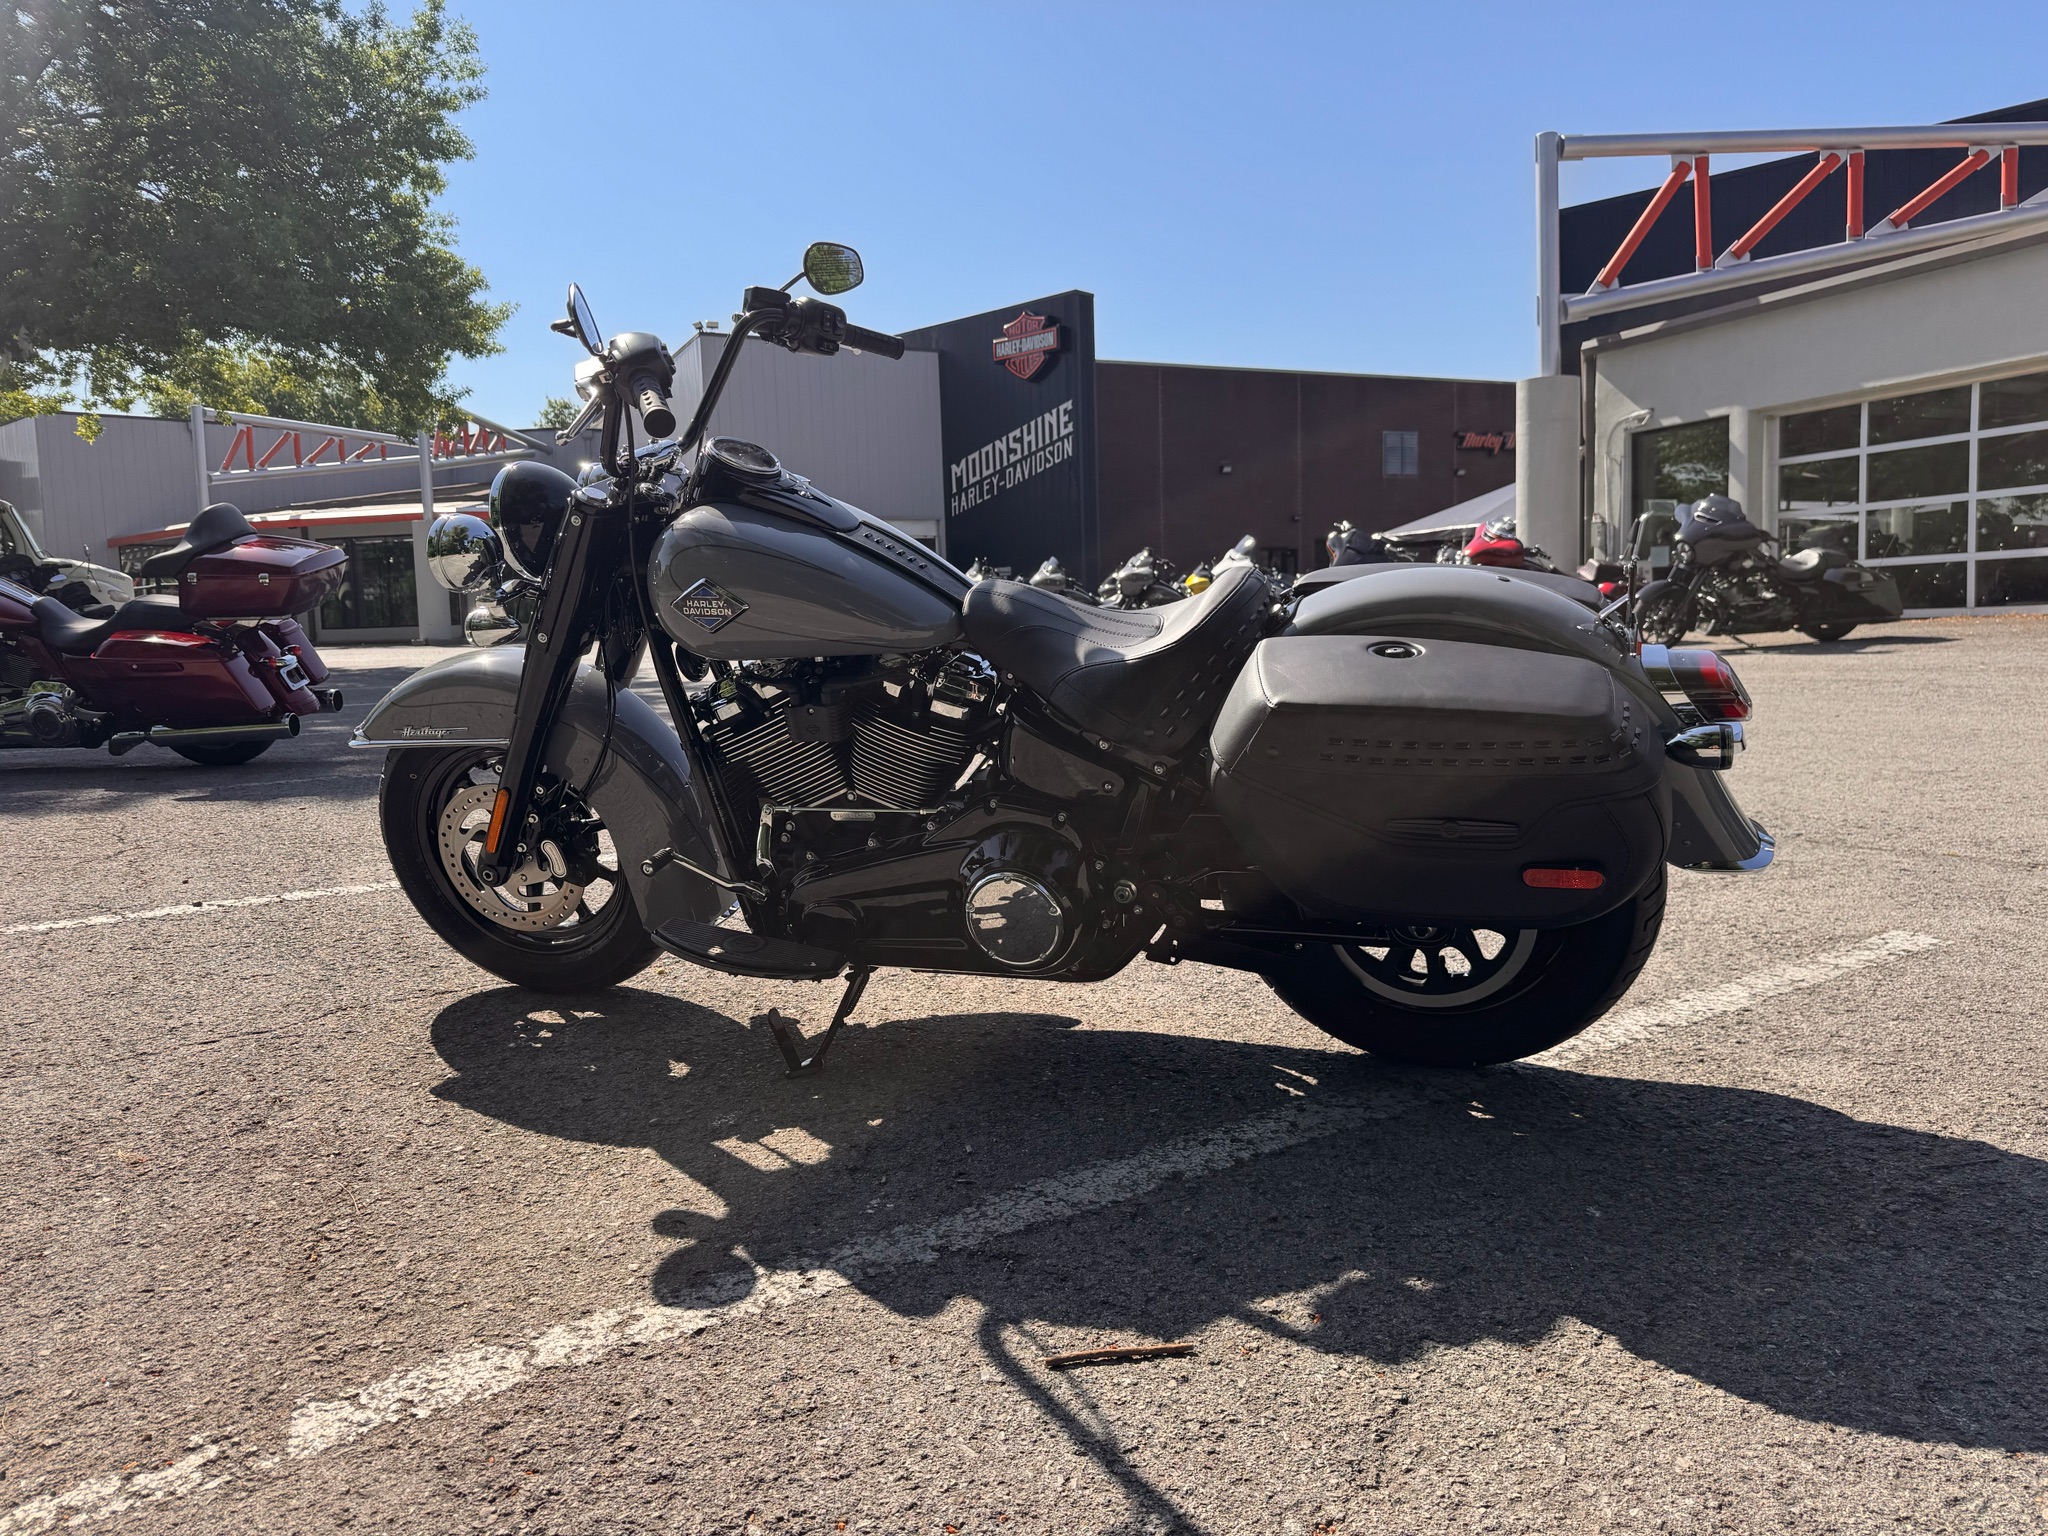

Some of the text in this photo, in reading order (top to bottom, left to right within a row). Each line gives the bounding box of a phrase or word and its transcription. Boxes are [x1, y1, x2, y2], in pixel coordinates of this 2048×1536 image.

[1009, 319, 1039, 335] MOTOR
[996, 331, 1054, 358] HARLEY-DAVIDSON
[1010, 352, 1040, 374] CYCLES
[951, 399, 1074, 494] MOONSHINE
[951, 435, 1074, 517] HARLEY-DAVIDSON
[683, 608, 732, 616] DAVIDSON
[686, 600, 727, 608] HARLEY-
[402, 726, 450, 738] Heritage
